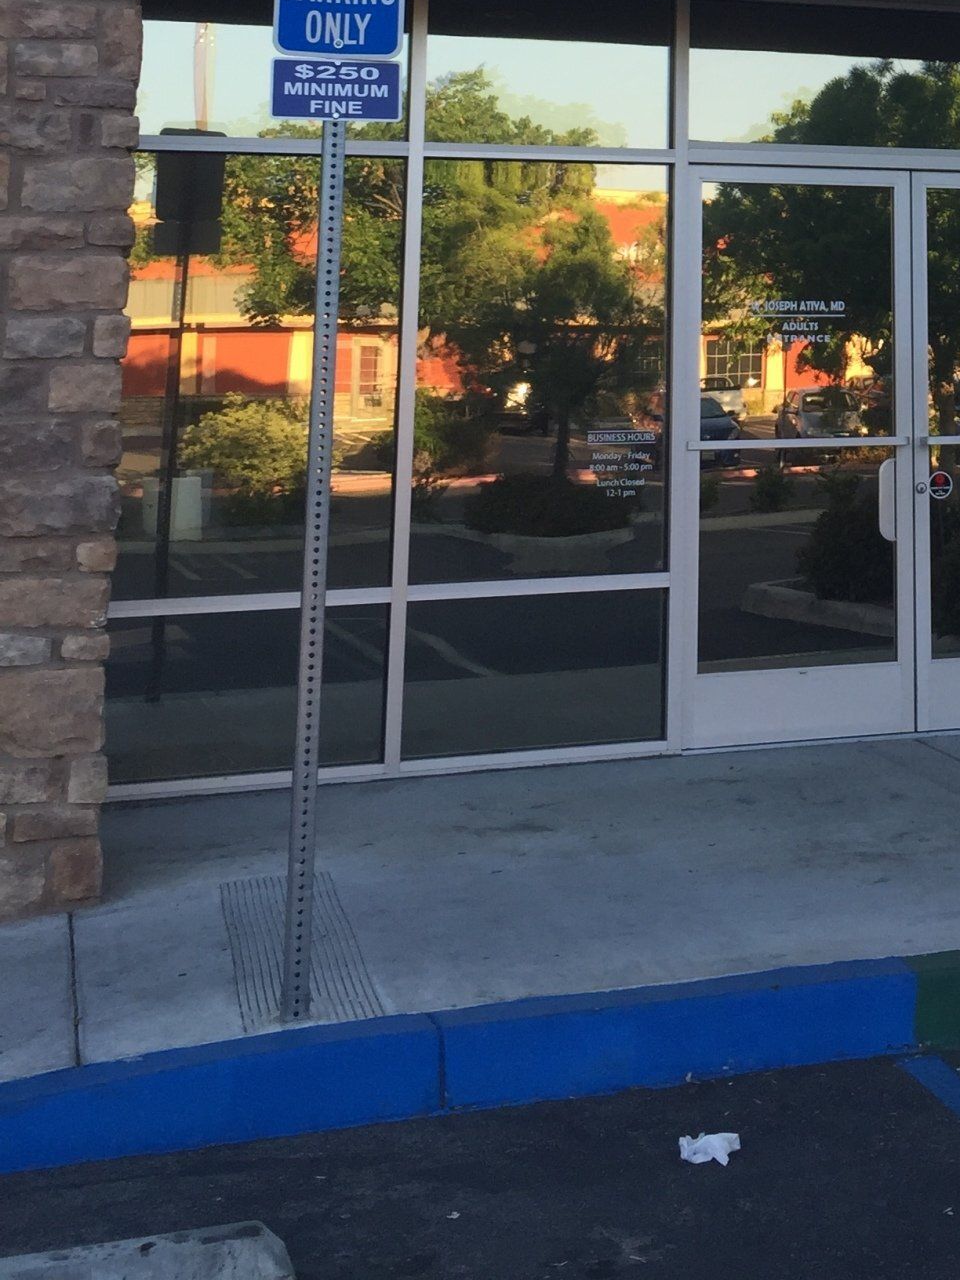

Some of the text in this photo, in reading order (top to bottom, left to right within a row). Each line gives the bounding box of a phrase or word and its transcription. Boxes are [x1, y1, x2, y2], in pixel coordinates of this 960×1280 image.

[305, 10, 372, 46] ONLY
[294, 63, 380, 81] $250
[283, 82, 389, 98] MINIMUM
[309, 100, 363, 115] FINE
[765, 300, 798, 312] JOSEPH
[800, 300, 829, 313] ATIYA,
[830, 300, 846, 312] MD
[782, 321, 819, 332] ADULTS
[587, 432, 656, 442] BUSINESS HOURS
[592, 452, 622, 461] Monday
[628, 451, 651, 461] Friday
[589, 464, 605, 472] 8:00
[623, 463, 640, 471] 5:00
[640, 464, 653, 473] pm
[596, 478, 645, 487] Lunch Closed
[623, 490, 636, 498] pm
